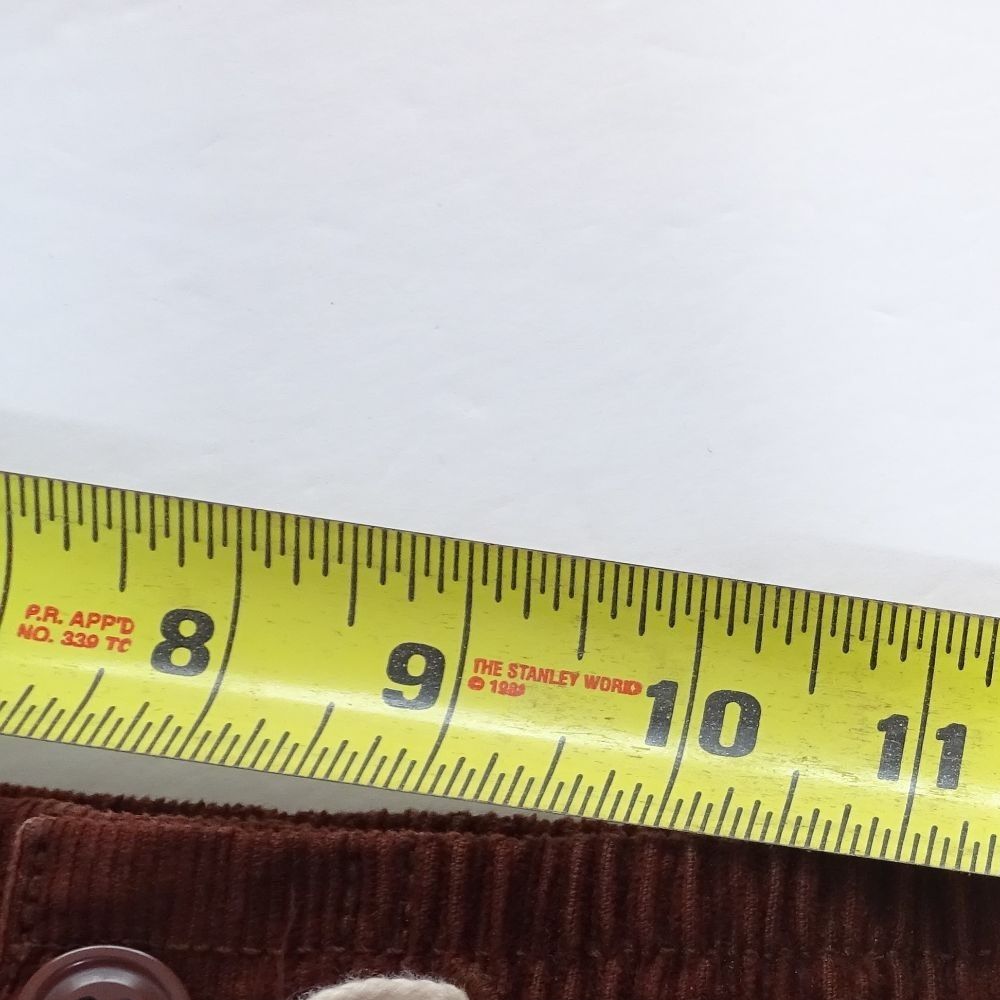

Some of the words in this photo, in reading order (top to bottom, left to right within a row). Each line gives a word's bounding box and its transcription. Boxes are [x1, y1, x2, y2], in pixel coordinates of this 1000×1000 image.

[17, 623, 54, 643] NO.
[60, 630, 99, 649] 339
[105, 635, 132, 653] TC
[25, 604, 63, 624] P.R.
[69, 611, 135, 635] APP'D
[151, 608, 214, 676] 8
[382, 642, 446, 711] 9
[473, 658, 503, 677] THE
[507, 662, 580, 687] STANLEY
[645, 680, 762, 757] 10
[877, 714, 967, 790] 11
